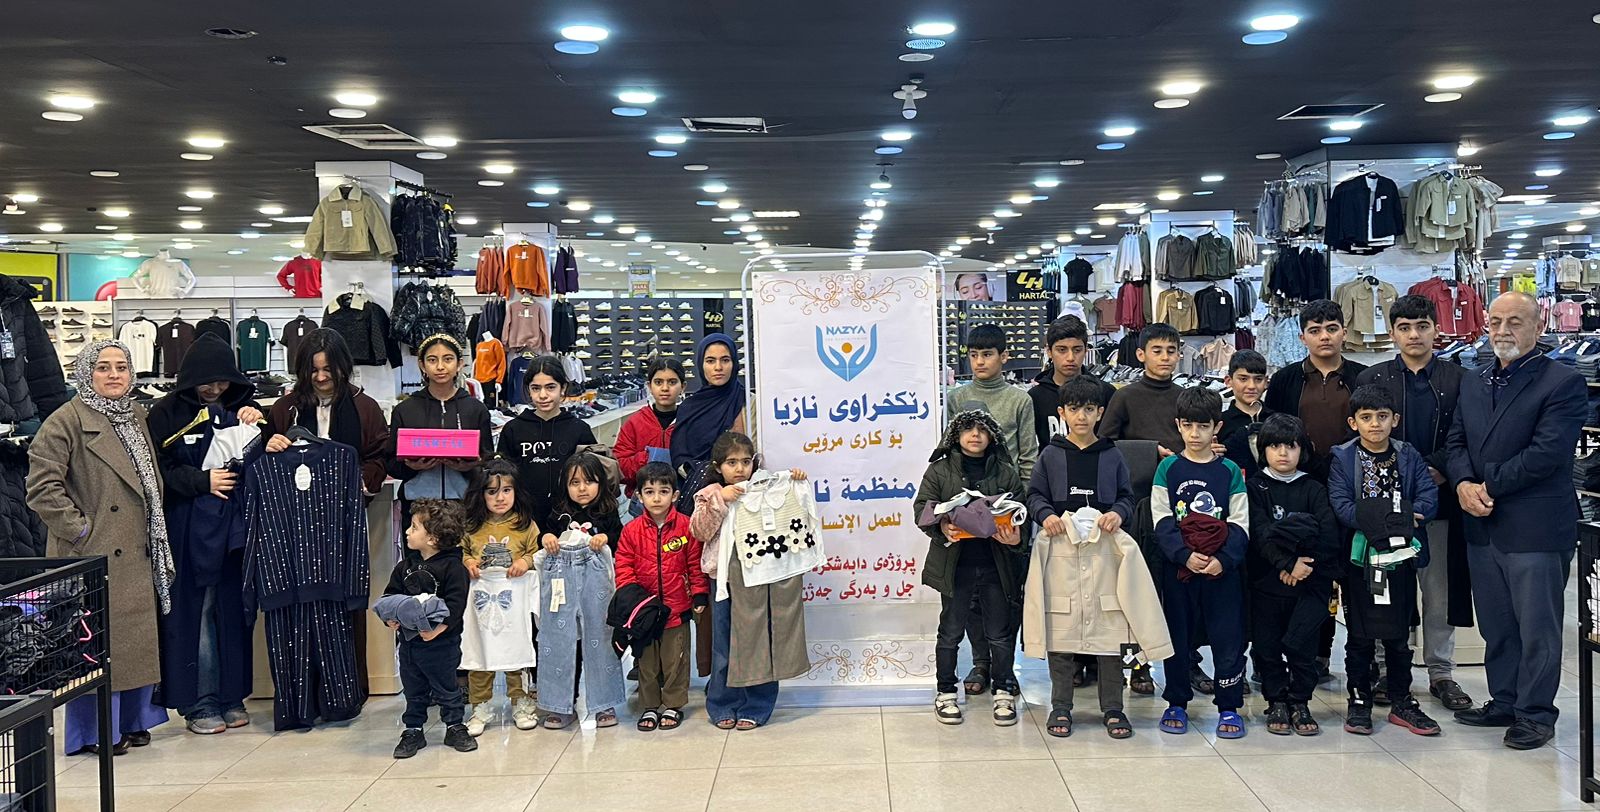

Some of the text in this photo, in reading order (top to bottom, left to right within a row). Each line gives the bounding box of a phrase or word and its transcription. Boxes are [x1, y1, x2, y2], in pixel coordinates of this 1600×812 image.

[826, 325, 866, 336] NAZYA
[773, 395, 818, 425] نازیا
[850, 430, 882, 449] کاری
[889, 430, 903, 449] بۆ
[841, 477, 917, 502] منظمة
[821, 511, 902, 533] للعمل الإنسا
[883, 583, 890, 598] و
[896, 580, 914, 597] جل
